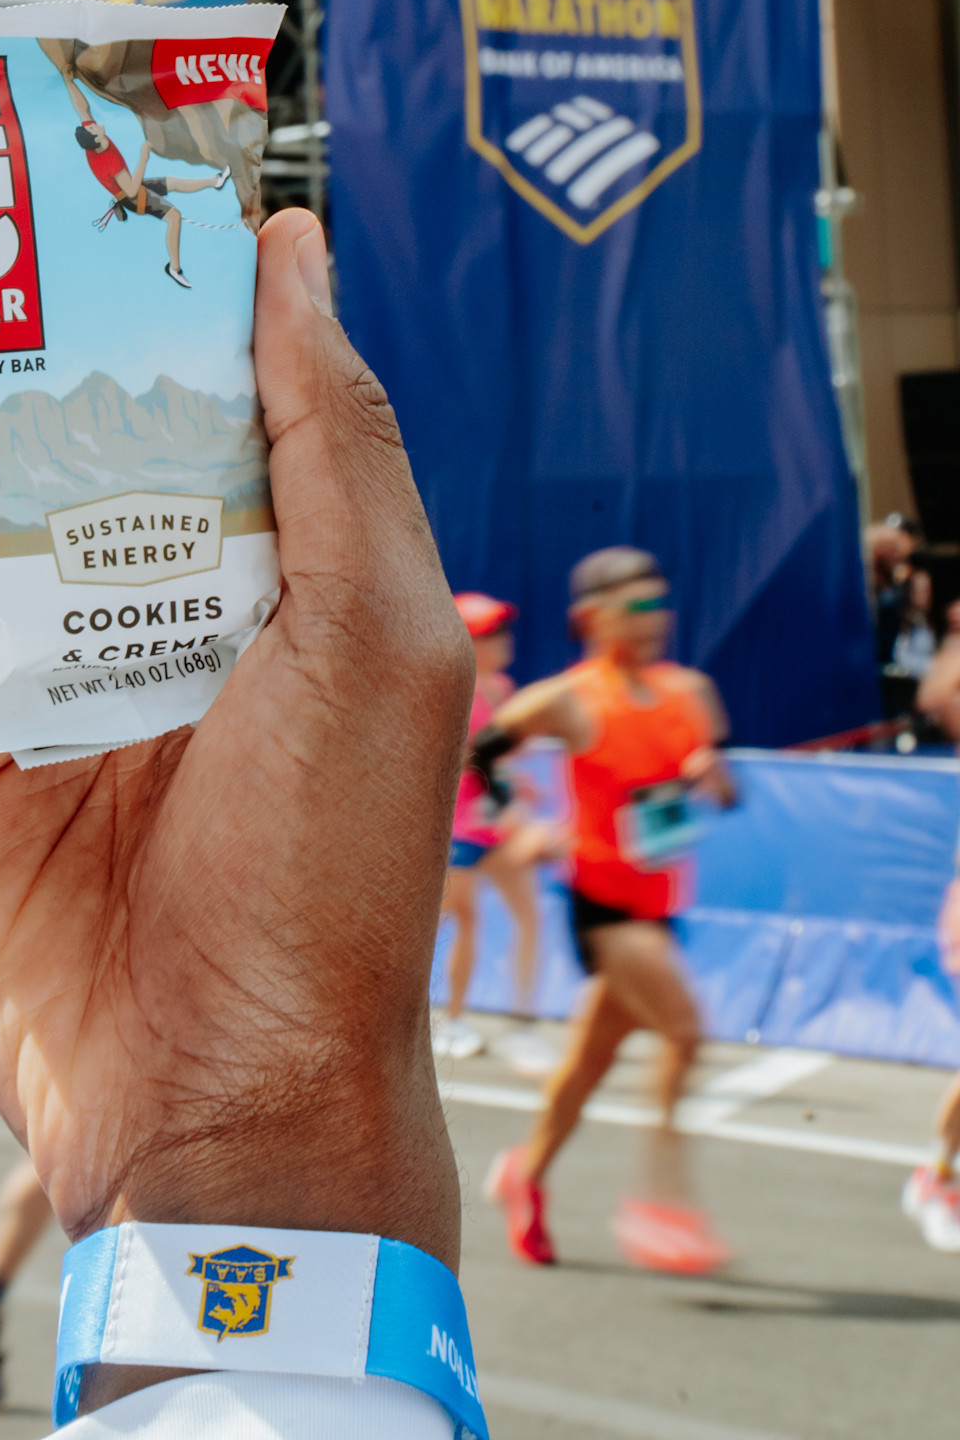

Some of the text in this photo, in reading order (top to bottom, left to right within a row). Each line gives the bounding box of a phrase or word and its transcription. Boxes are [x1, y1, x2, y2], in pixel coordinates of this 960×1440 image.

[175, 53, 262, 86] NEW!
[12, 357, 46, 373] BAR
[66, 514, 209, 546] SUSTAINED
[83, 542, 196, 569] ENERGY
[62, 596, 223, 635] COOKIES
[62, 634, 219, 663] & CREME
[47, 684, 79, 706] NET
[80, 678, 107, 695] WT
[148, 662, 174, 682] OZ
[175, 648, 222, 678] (68g)
